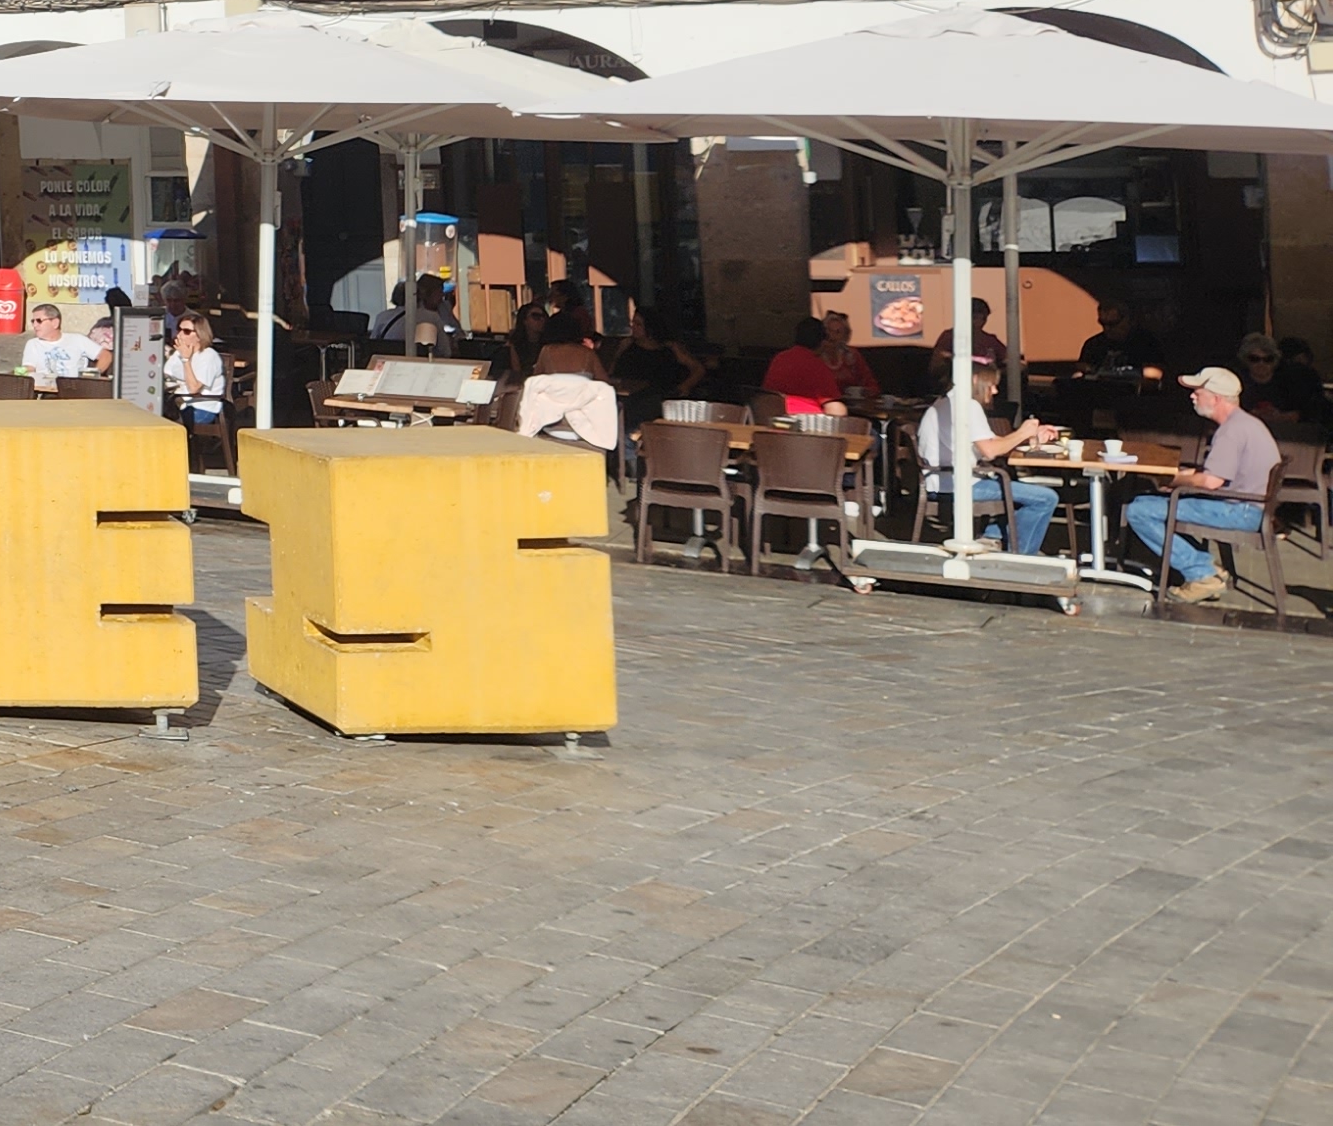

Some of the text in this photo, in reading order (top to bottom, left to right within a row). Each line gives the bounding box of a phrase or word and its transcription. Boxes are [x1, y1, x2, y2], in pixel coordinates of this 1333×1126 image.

[40, 179, 111, 193] PONLE COLOR
[48, 204, 56, 217] A
[59, 204, 71, 217] LA
[52, 227, 103, 240] EL SABOR
[44, 250, 112, 264] LO PONEMOS
[48, 274, 109, 288] NOSOTROS.
